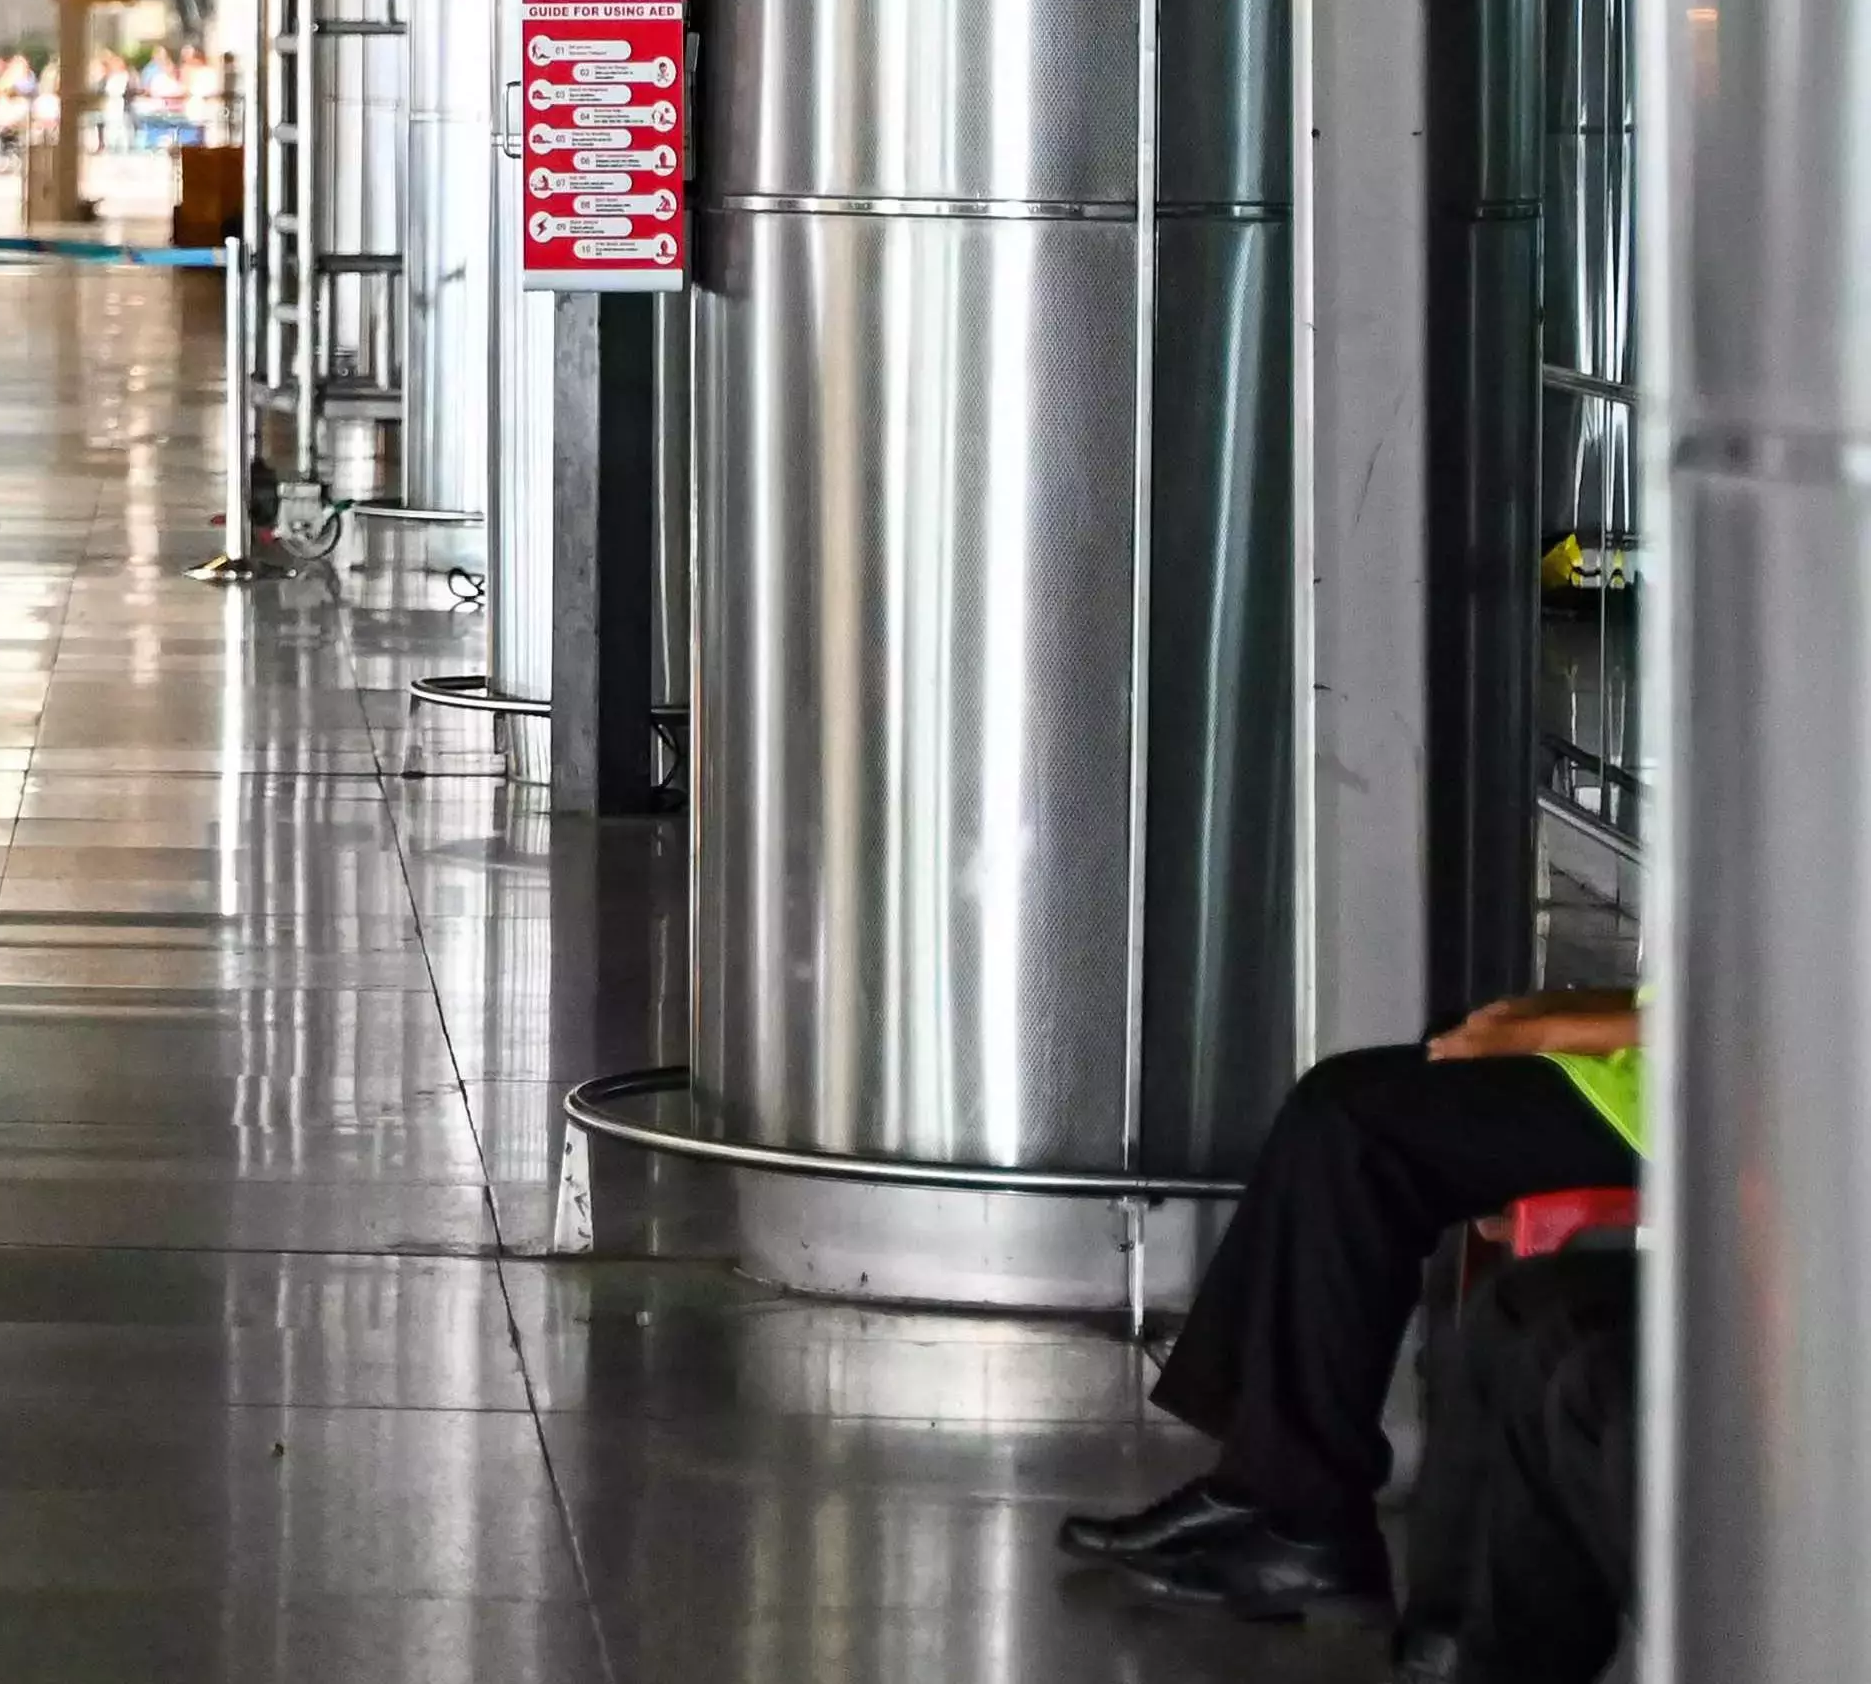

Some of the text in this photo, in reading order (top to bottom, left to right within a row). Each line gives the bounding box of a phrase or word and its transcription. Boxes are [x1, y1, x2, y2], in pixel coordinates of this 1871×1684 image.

[529, 6, 675, 17] GUIDE FOR USING AED
